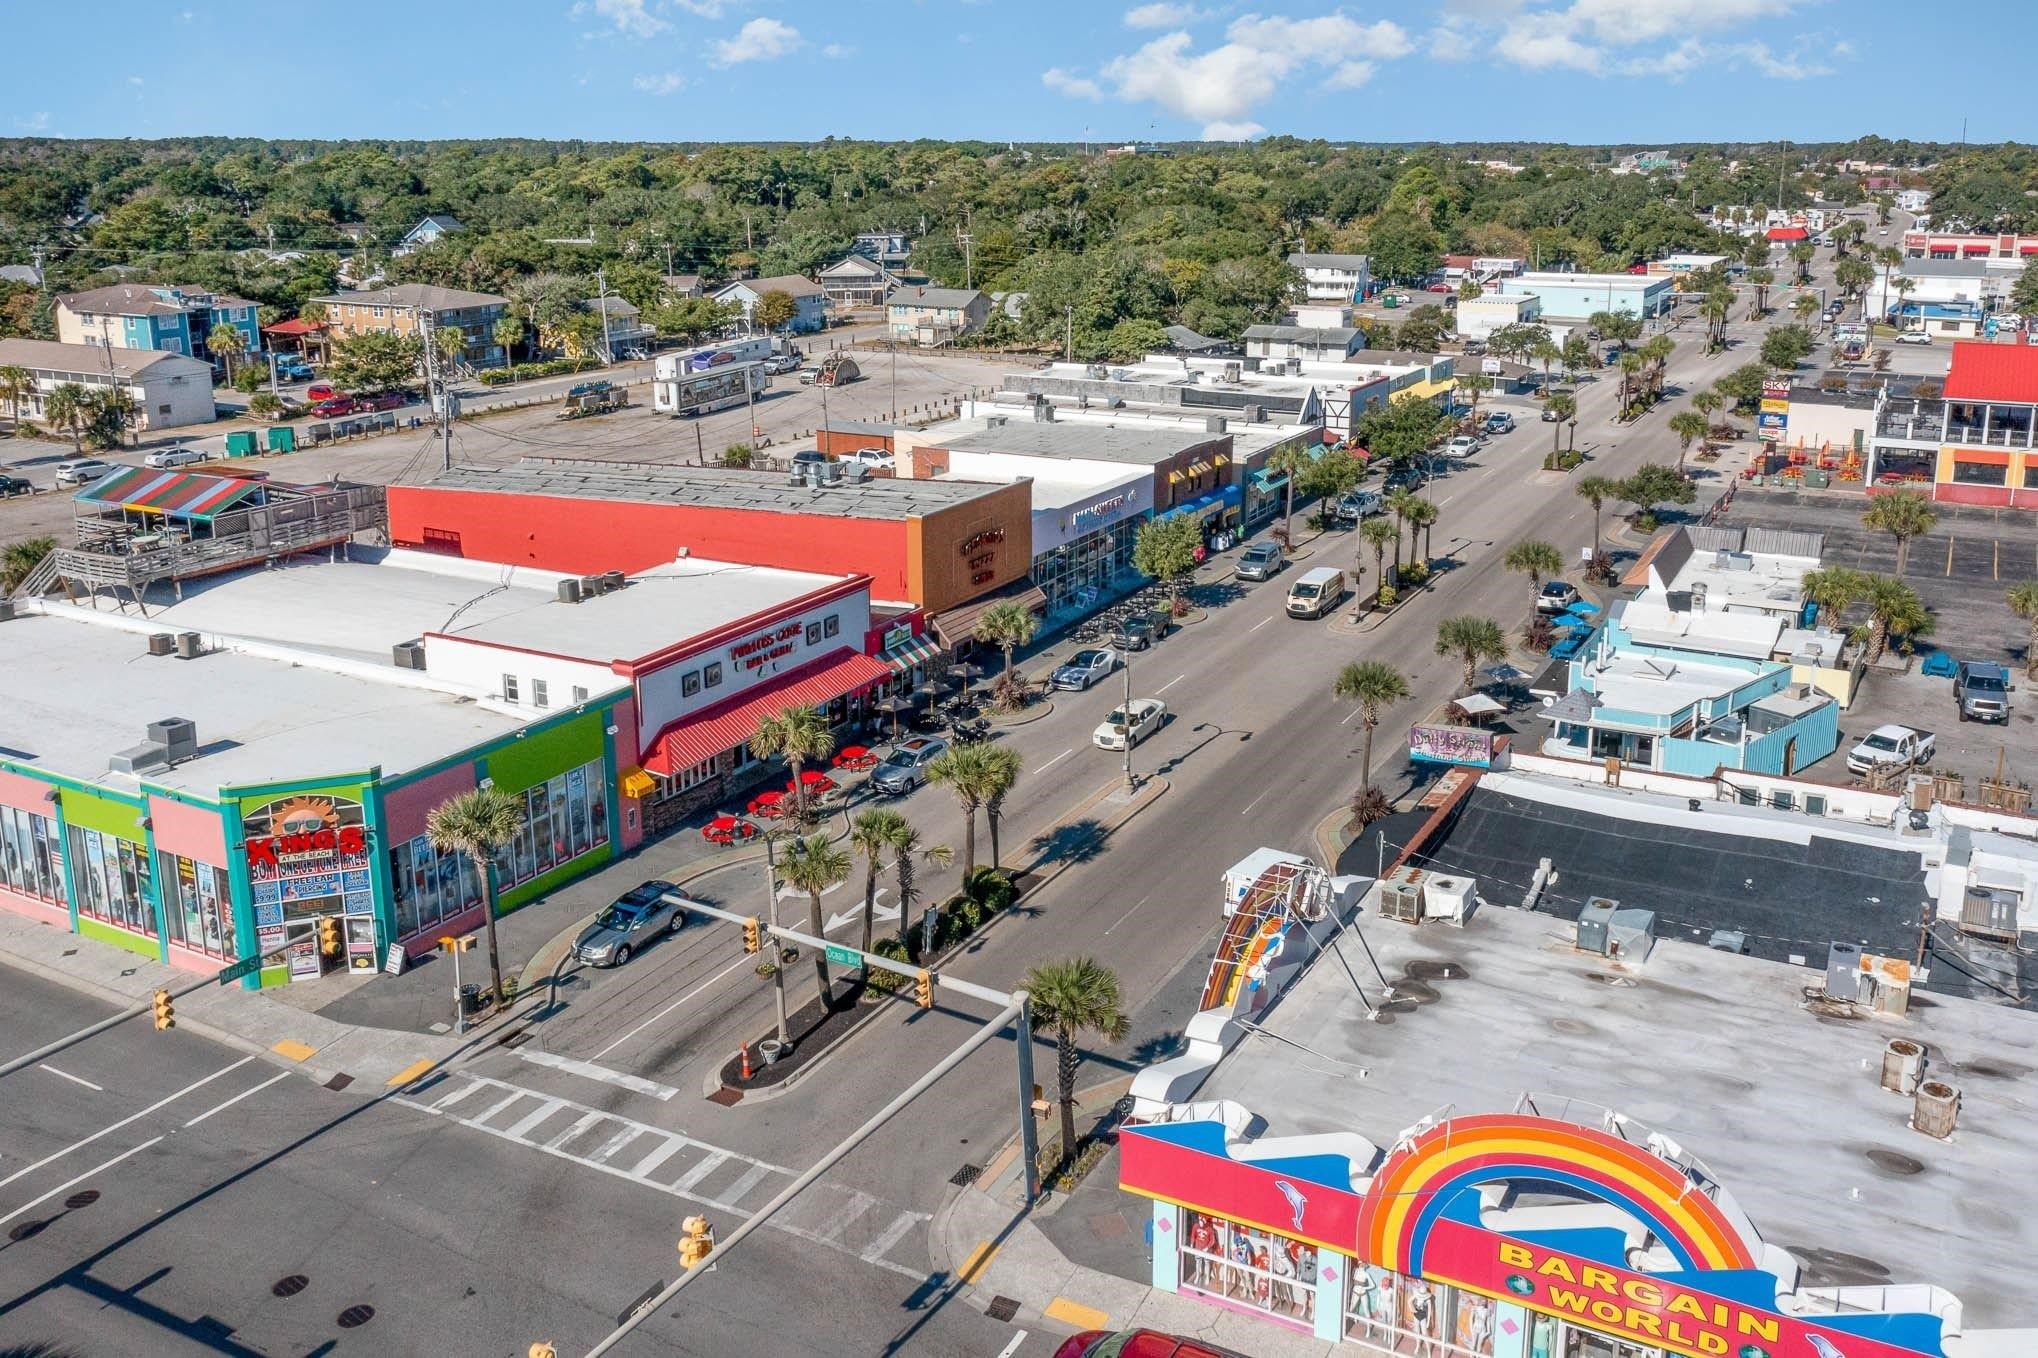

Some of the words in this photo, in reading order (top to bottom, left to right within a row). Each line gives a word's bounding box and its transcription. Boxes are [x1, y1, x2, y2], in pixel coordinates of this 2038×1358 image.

[1764, 381, 1788, 389] SKY
[308, 851, 330, 859] BEACH
[250, 859, 275, 881] BUY
[280, 860, 299, 877] ONE
[319, 856, 340, 873] ONE
[341, 850, 368, 869] FREE
[287, 876, 310, 886] FREE
[313, 874, 334, 884] EAR
[297, 883, 328, 894] PIERCING
[257, 926, 281, 935] $5.00
[220, 966, 245, 983] Main
[249, 957, 260, 970] St
[1498, 1241, 1780, 1343] BARGAIN
[1548, 1286, 1731, 1355] WORLD
